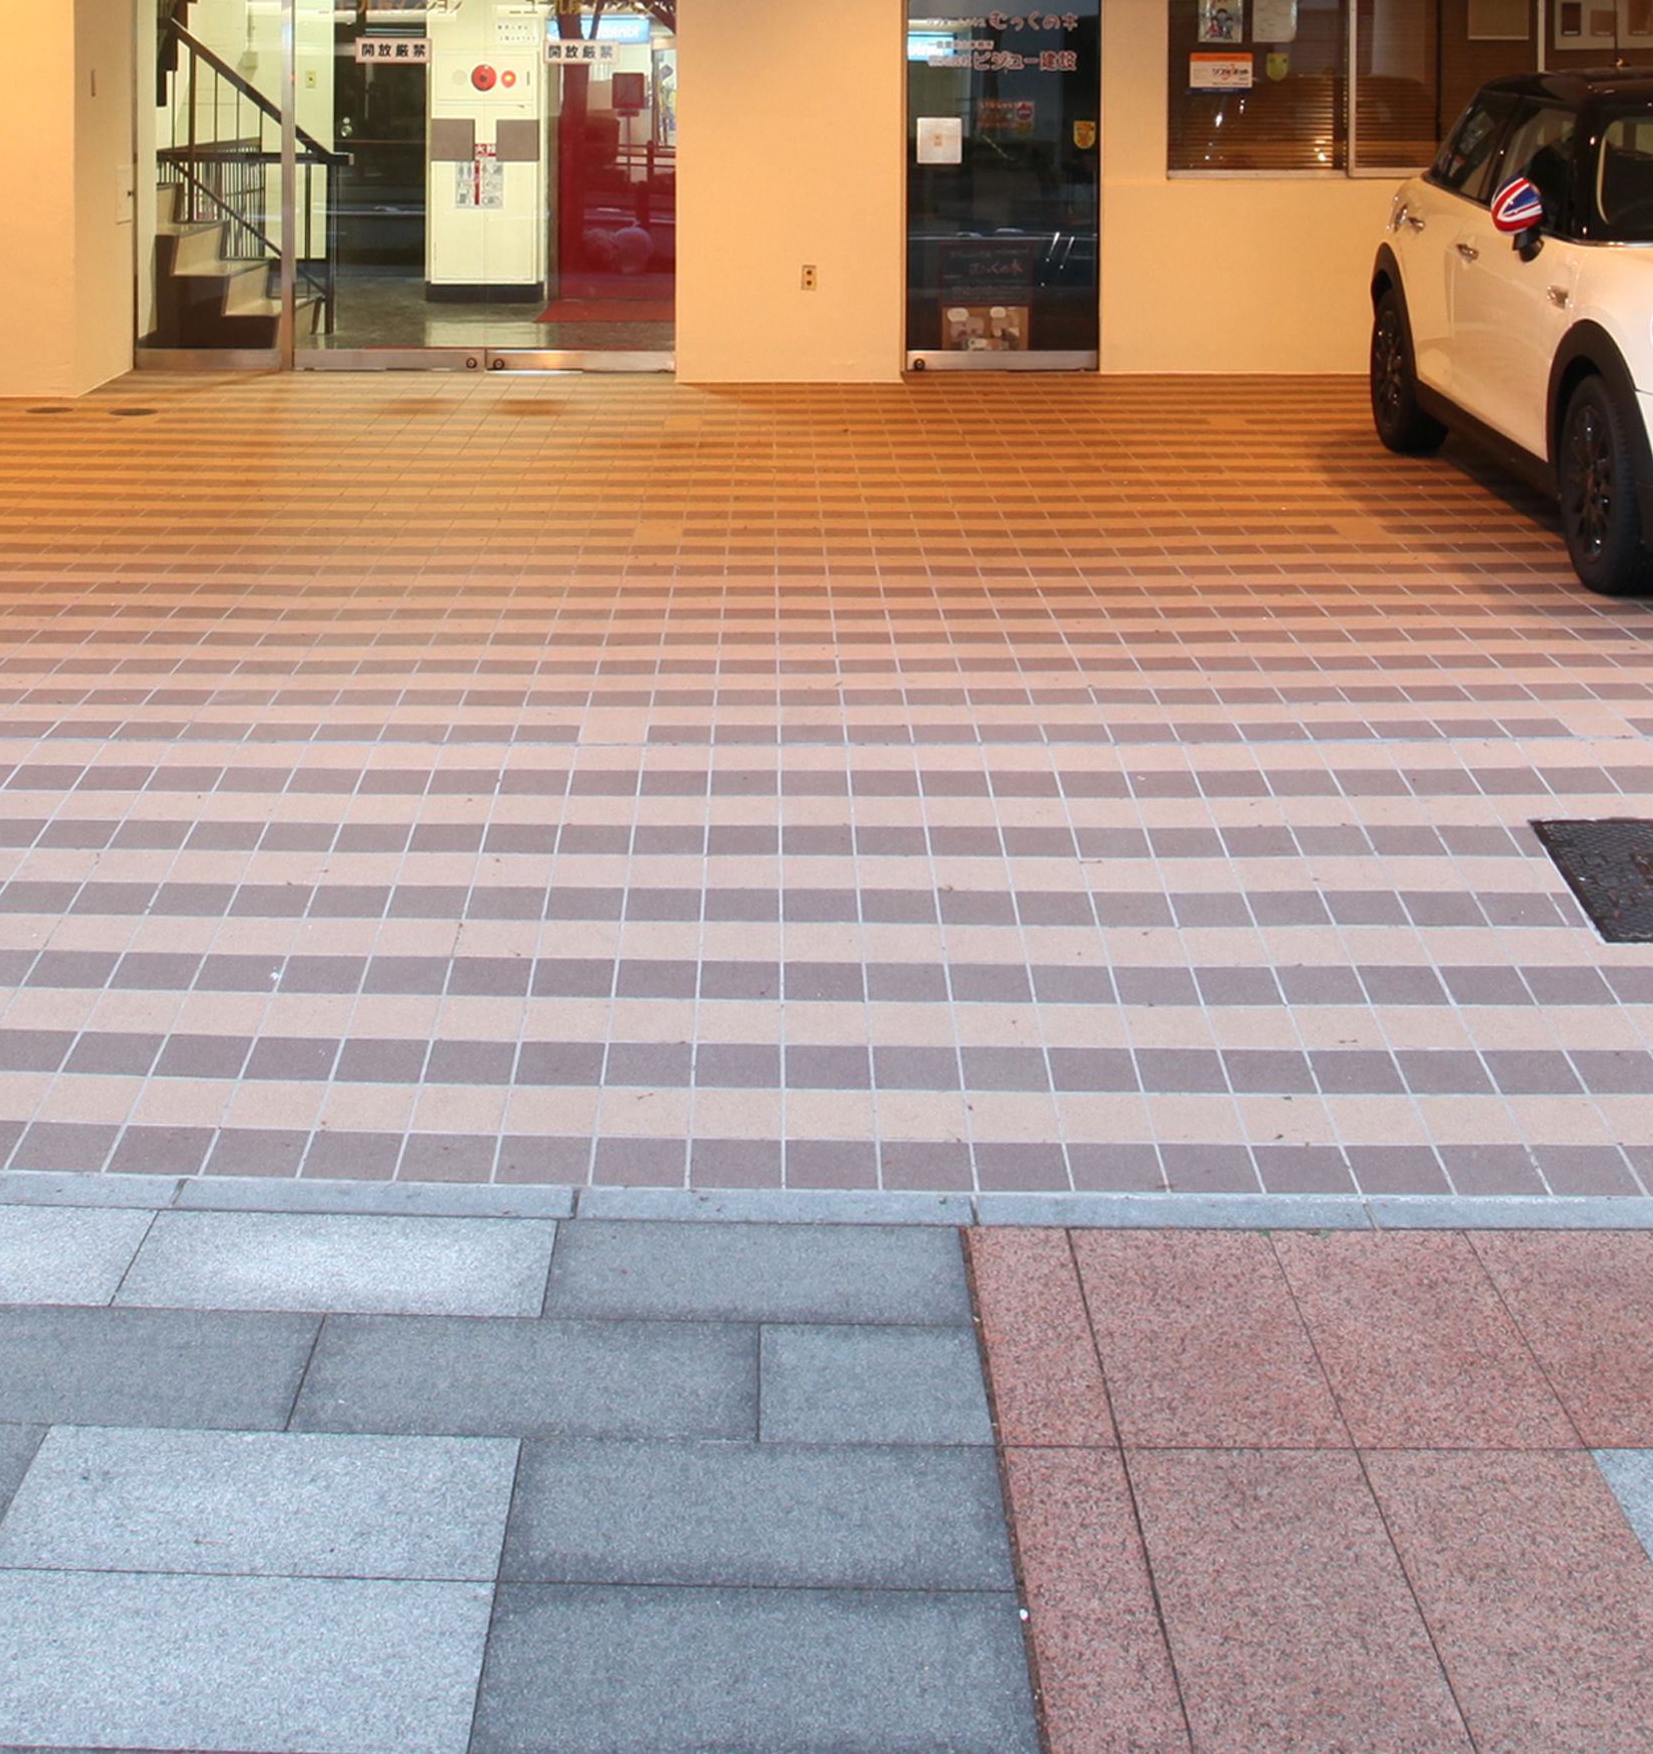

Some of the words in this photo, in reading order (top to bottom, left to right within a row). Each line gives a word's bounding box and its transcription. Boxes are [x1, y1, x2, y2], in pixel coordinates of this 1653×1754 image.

[360, 43, 427, 59] 開放厳禁
[548, 44, 614, 59] 開放厳禁
